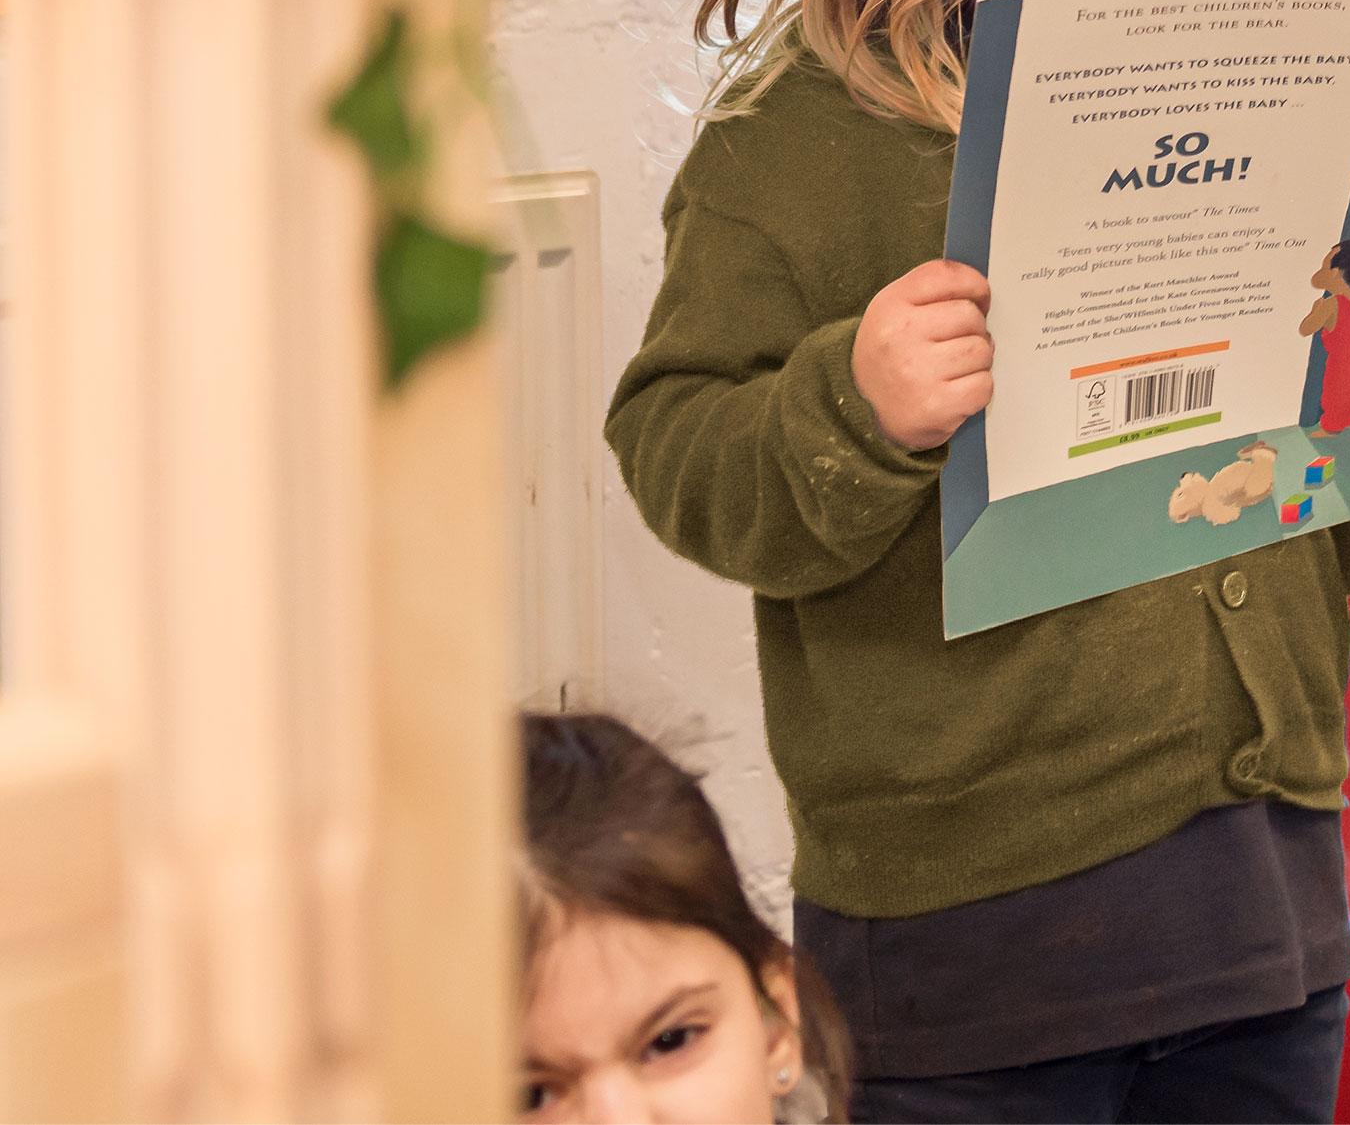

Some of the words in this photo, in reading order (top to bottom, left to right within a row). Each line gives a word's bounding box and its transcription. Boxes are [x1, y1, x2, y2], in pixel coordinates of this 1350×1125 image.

[1113, 7, 1143, 18] THE
[1151, 4, 1188, 16] BEST
[1291, 1, 1346, 12] BOOKS,
[1126, 24, 1165, 36] LOOK
[1173, 22, 1201, 32] FOR
[1208, 20, 1239, 30] THE
[1246, 18, 1288, 29] BEAR.
[1035, 65, 1125, 84] EVERYBODY
[1130, 60, 1183, 73] WANTS
[1188, 58, 1208, 69] TO
[1213, 55, 1277, 67] SQUEEZE
[1282, 55, 1311, 65] THE
[1049, 86, 1139, 104] EVERYBODY
[1143, 81, 1197, 93] WANTS
[1201, 79, 1222, 89] TO
[1226, 77, 1255, 88] KISS
[1260, 76, 1288, 86] THE
[1294, 75, 1336, 85] BABY,
[1072, 106, 1161, 124] EVERYBODY
[1165, 102, 1210, 115] LOVES
[1214, 100, 1243, 111] THE
[1248, 99, 1288, 109] BABY
[1154, 132, 1209, 159] SO
[1101, 157, 1252, 193] MUCH!
[1102, 217, 1133, 229] book
[1136, 214, 1149, 225] to
[1203, 206, 1224, 217] The
[1228, 204, 1259, 216] Times
[1096, 243, 1122, 255] very
[1125, 238, 1163, 251] young
[1166, 232, 1204, 245] babies
[1207, 230, 1229, 240] can
[1232, 226, 1266, 240] enjoy
[1021, 266, 1055, 281] really
[1057, 262, 1088, 278] good
[1091, 256, 1133, 273] picture
[1136, 250, 1167, 263] book
[1170, 247, 1192, 260] like
[1196, 245, 1219, 256] this
[1254, 239, 1281, 251] Time
[1284, 238, 1307, 248] Out
[1080, 289, 1113, 299] Winner
[1115, 286, 1126, 294] of
[1127, 284, 1141, 292] the
[1143, 281, 1165, 290] Kurt
[1166, 275, 1207, 287] Maschler
[1209, 270, 1240, 280] Award
[1041, 324, 1074, 334] Winner
[1076, 320, 1087, 328] of
[1087, 318, 1102, 326] the
[1169, 303, 1197, 312] Under
[1199, 300, 1221, 309] Fives
[1223, 296, 1246, 305] Book
[1247, 294, 1271, 303] Prize
[1044, 309, 1075, 320] Highly
[1077, 299, 1133, 314] Commended
[1151, 294, 1165, 302] the
[1167, 291, 1188, 300] Kate
[1190, 285, 1241, 297] Greenaway
[1242, 280, 1271, 290] Medal
[1034, 342, 1049, 351] An
[1092, 330, 1111, 340] Best
[1160, 318, 1181, 328] Book
[1184, 315, 1198, 324] for
[1200, 310, 1236, 321] Younger
[1238, 306, 1274, 316] Readers
